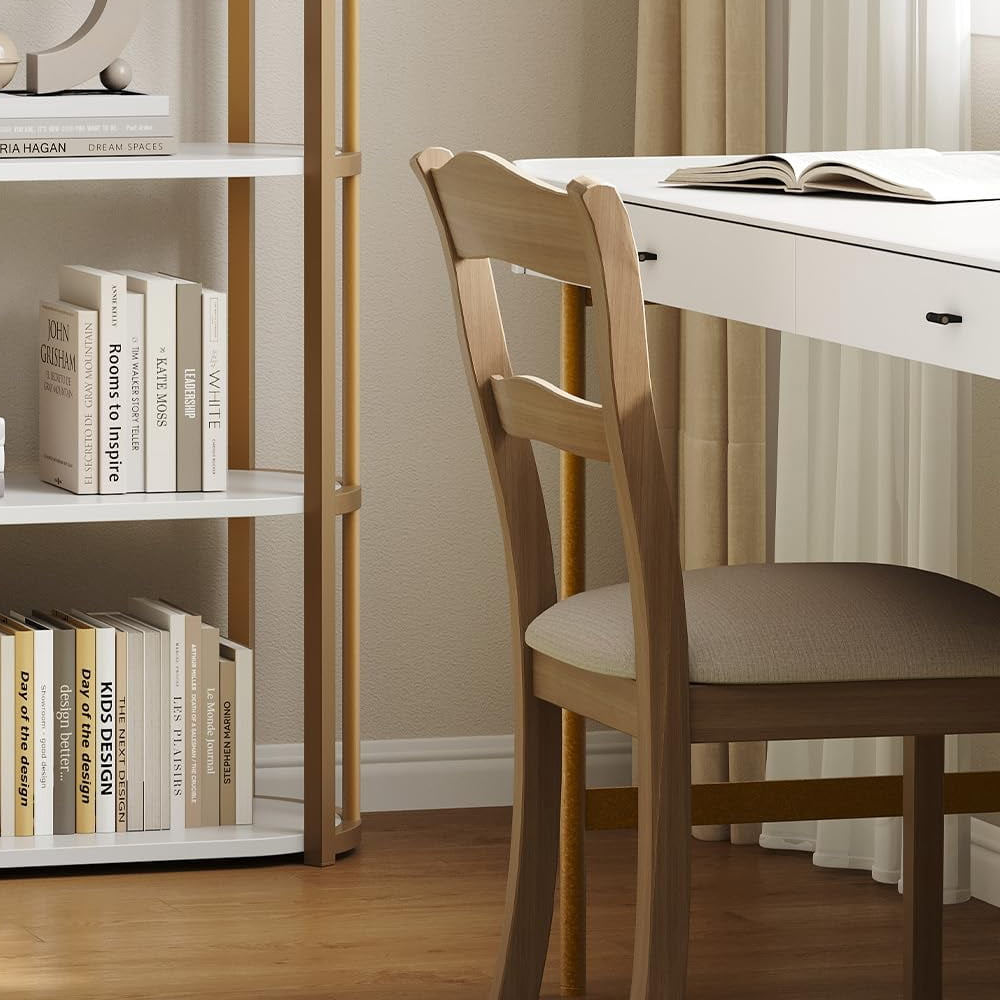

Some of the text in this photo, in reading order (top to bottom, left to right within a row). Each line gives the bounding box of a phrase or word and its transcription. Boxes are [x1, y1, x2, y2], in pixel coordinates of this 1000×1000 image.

[23, 142, 67, 153] HAGAN
[88, 143, 123, 152] DREAM
[127, 142, 164, 151] SPACES
[40, 344, 76, 372] GRISHAM
[47, 319, 70, 342] JOHN
[85, 322, 93, 485] EL SECRETO DE GRAY MOUNTAIN
[105, 344, 122, 483] Rooms to Inspire
[131, 346, 139, 451] TIM WALKER STORY TELLER
[157, 358, 167, 427] KATE MOSS
[184, 369, 196, 419] LEADERSHIP
[209, 369, 221, 429] WHITE
[19, 671, 29, 807] Day of the design
[56, 685, 72, 728] design
[80, 669, 91, 804] Day of the design
[100, 682, 112, 795] KIDS DESIGN
[173, 696, 182, 796] LES PLAISIRS
[206, 688, 215, 774] Le Monde Journal
